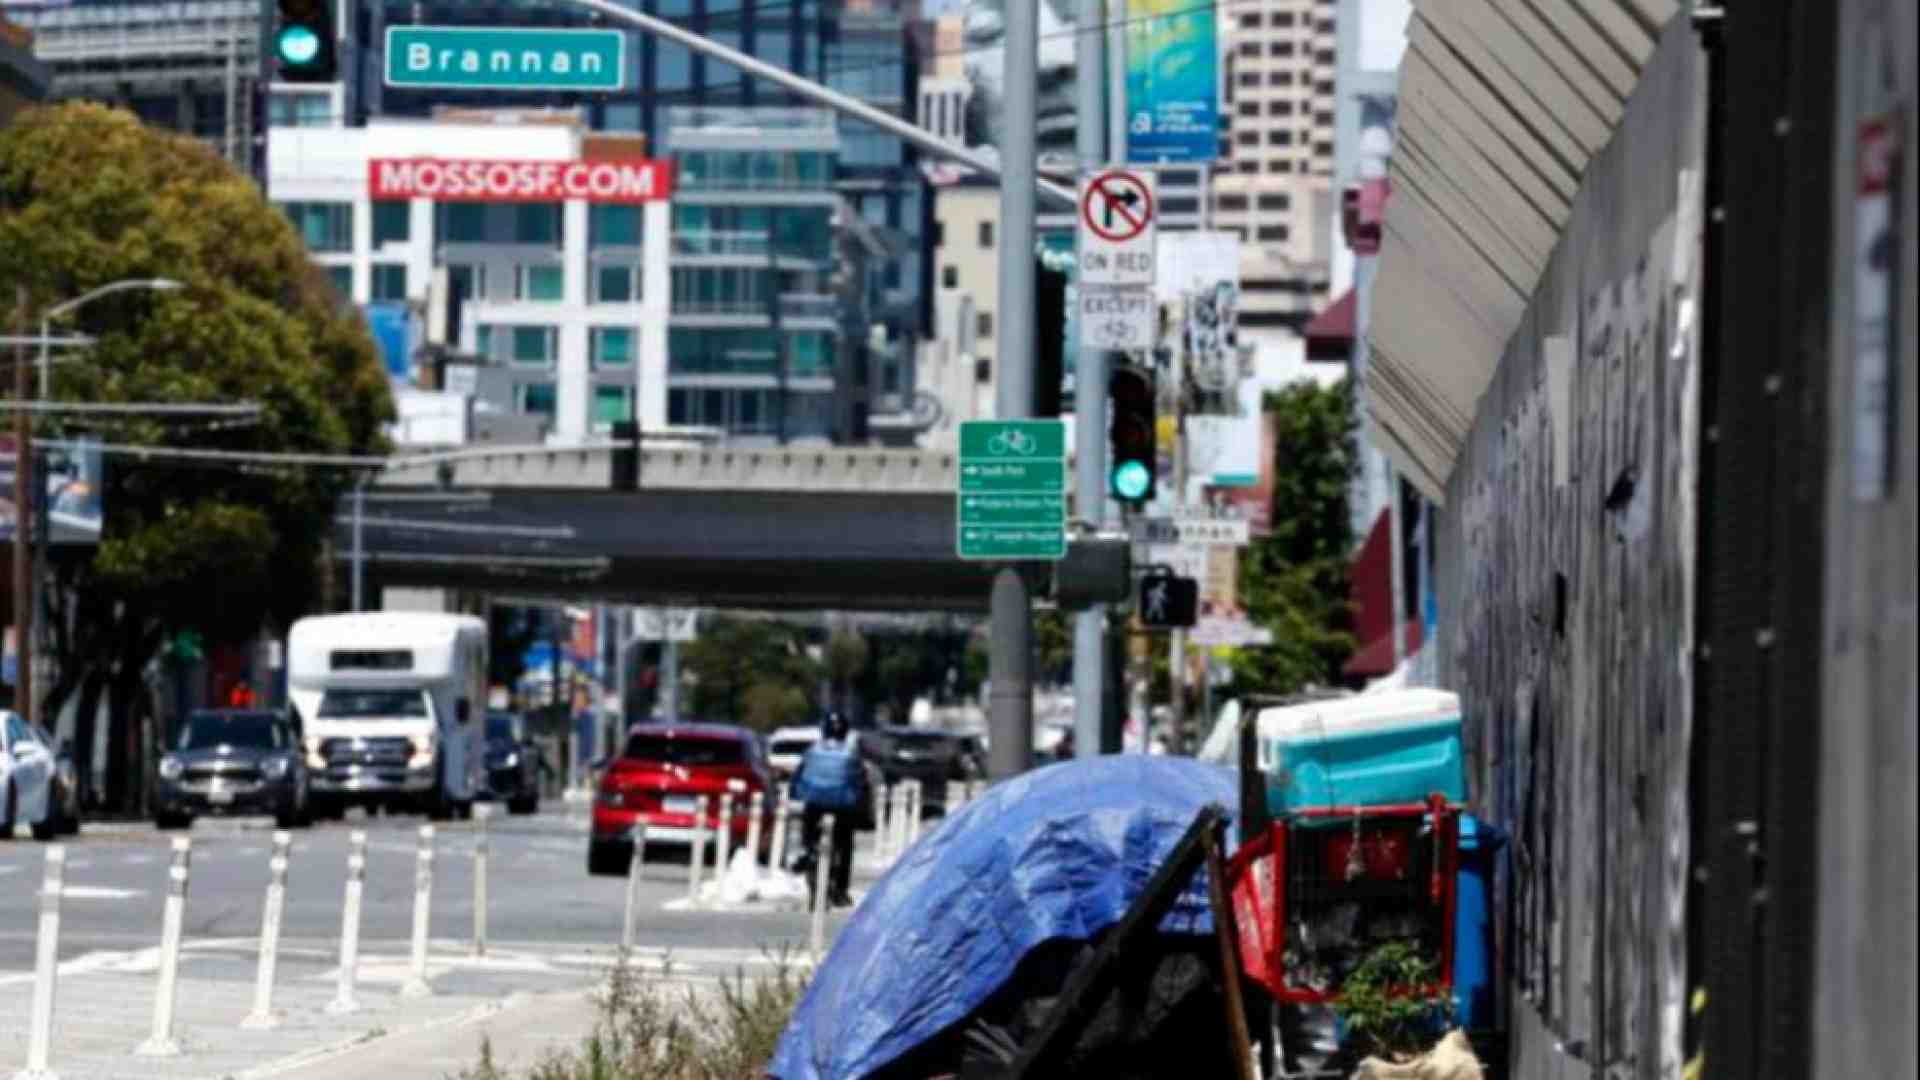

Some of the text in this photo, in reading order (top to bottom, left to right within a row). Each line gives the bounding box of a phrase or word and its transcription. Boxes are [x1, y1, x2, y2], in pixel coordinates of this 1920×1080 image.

[407, 43, 602, 73] Brannan
[379, 162, 656, 196] MOSSOSF.COM
[1083, 252, 1152, 271] ON RED
[1084, 299, 1146, 314] EXCEPT
